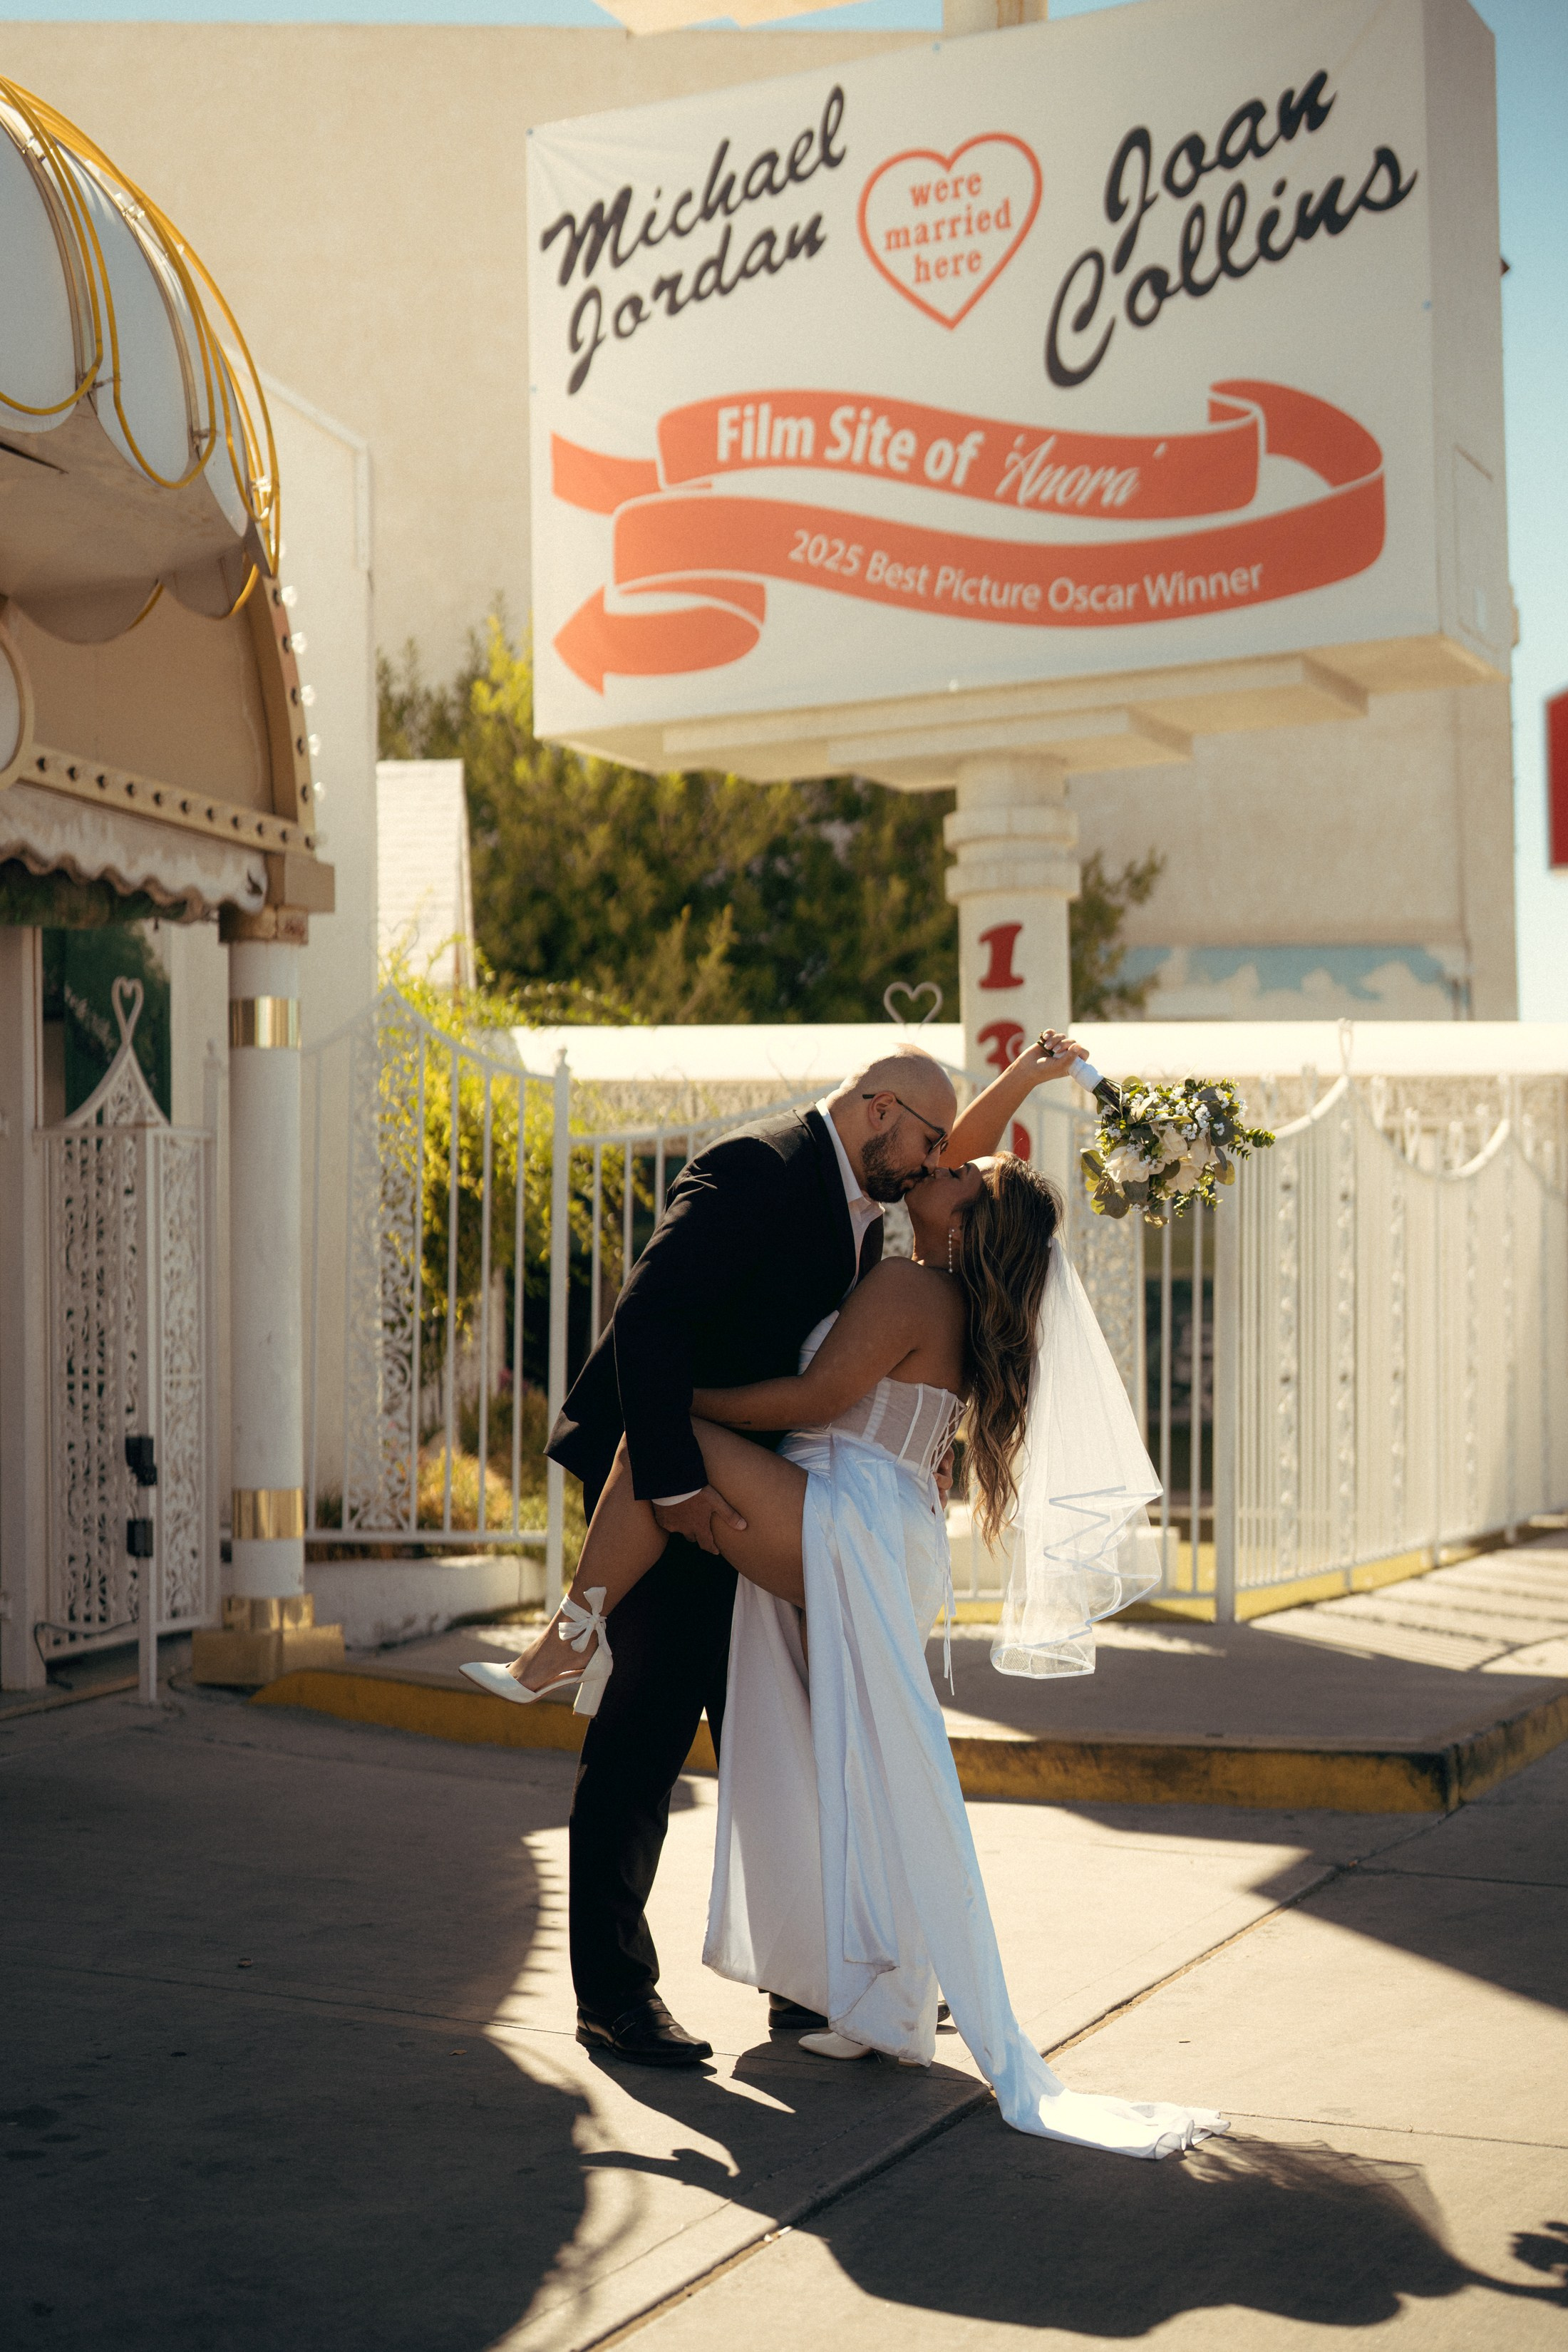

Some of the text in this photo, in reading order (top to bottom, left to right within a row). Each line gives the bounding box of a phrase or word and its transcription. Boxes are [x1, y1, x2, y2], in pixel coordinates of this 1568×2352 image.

[540, 83, 847, 287] Michael
[909, 172, 982, 207] were
[1104, 68, 1337, 274] Joan
[884, 197, 1011, 251] married
[914, 250, 982, 283] here
[1044, 145, 1418, 389] Collins
[567, 212, 827, 396] Jordan
[717, 402, 815, 462] Film
[823, 404, 917, 473] Site
[923, 430, 985, 488] of
[788, 529, 1264, 612] 2025 Best Picture Oscar Winner
